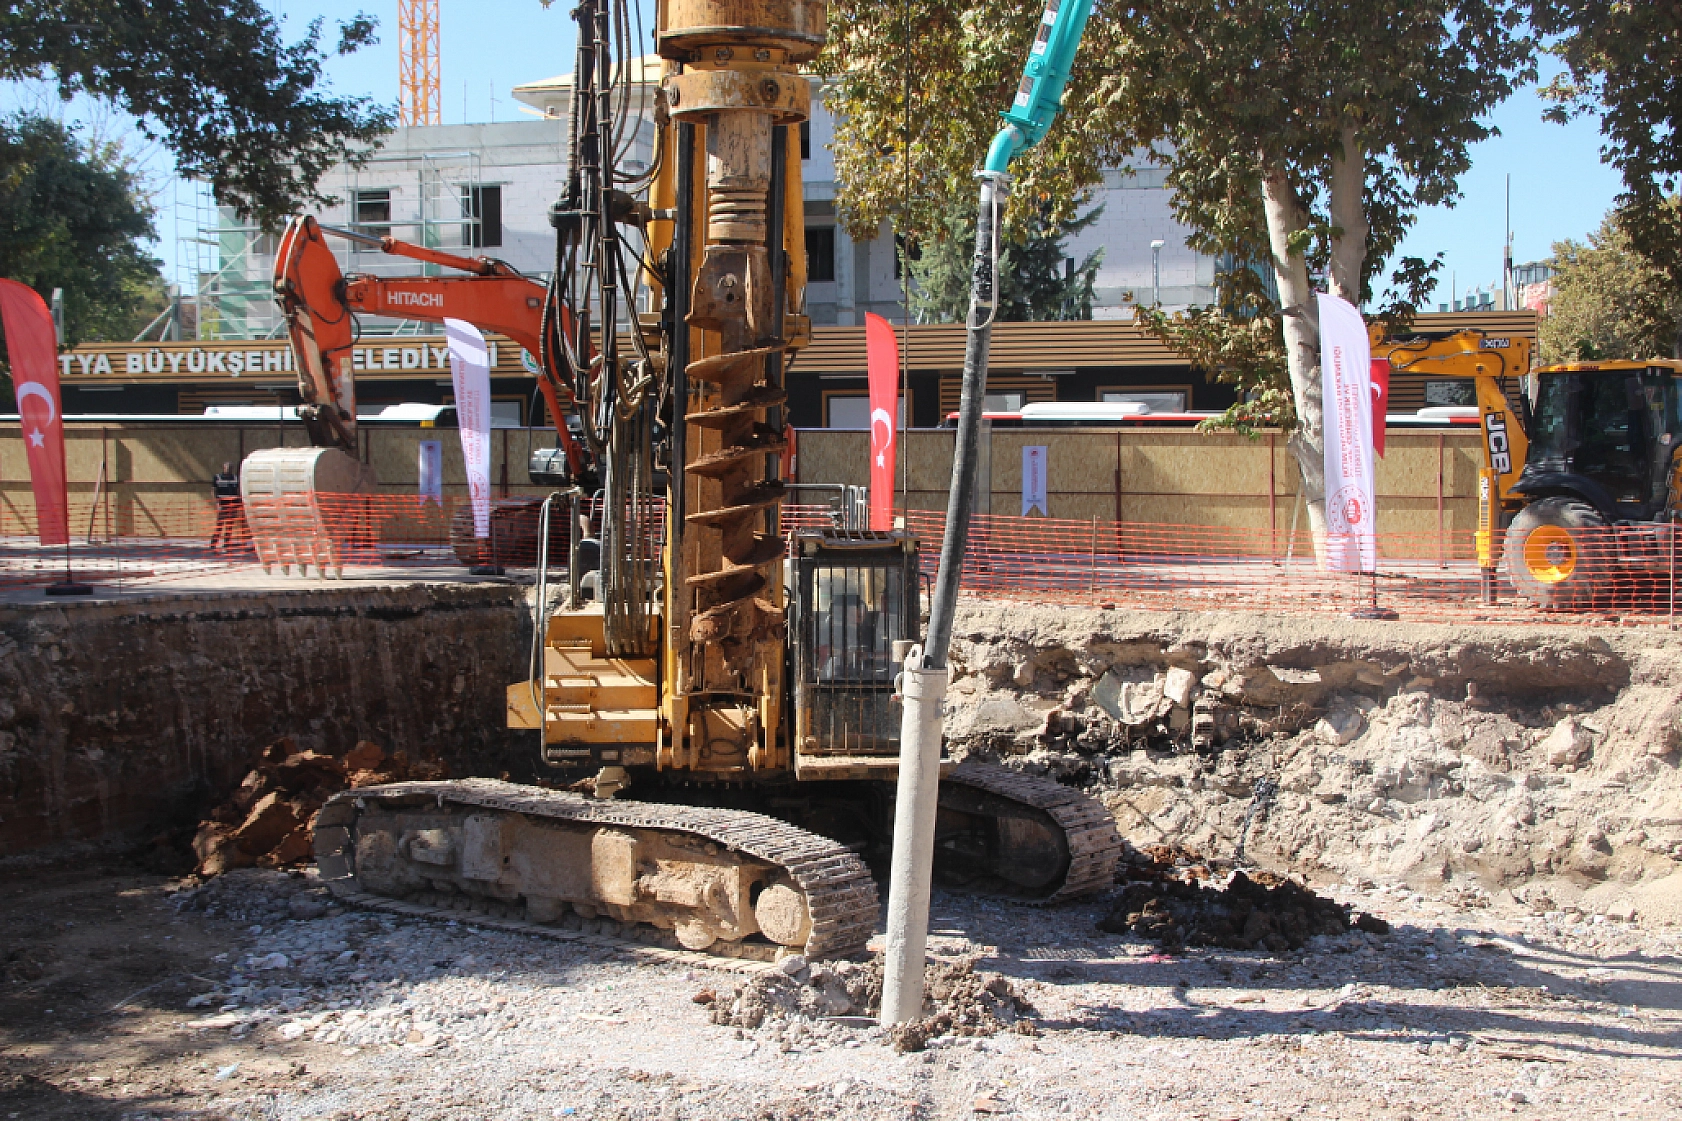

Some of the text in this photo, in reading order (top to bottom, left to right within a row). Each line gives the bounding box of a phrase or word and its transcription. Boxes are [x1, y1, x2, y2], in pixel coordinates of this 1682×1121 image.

[387, 291, 444, 307] HITACHI
[58, 341, 498, 377] TYA BÜYÜKŞEHİ ELEDİYİ
[1486, 413, 1512, 473] JCB
